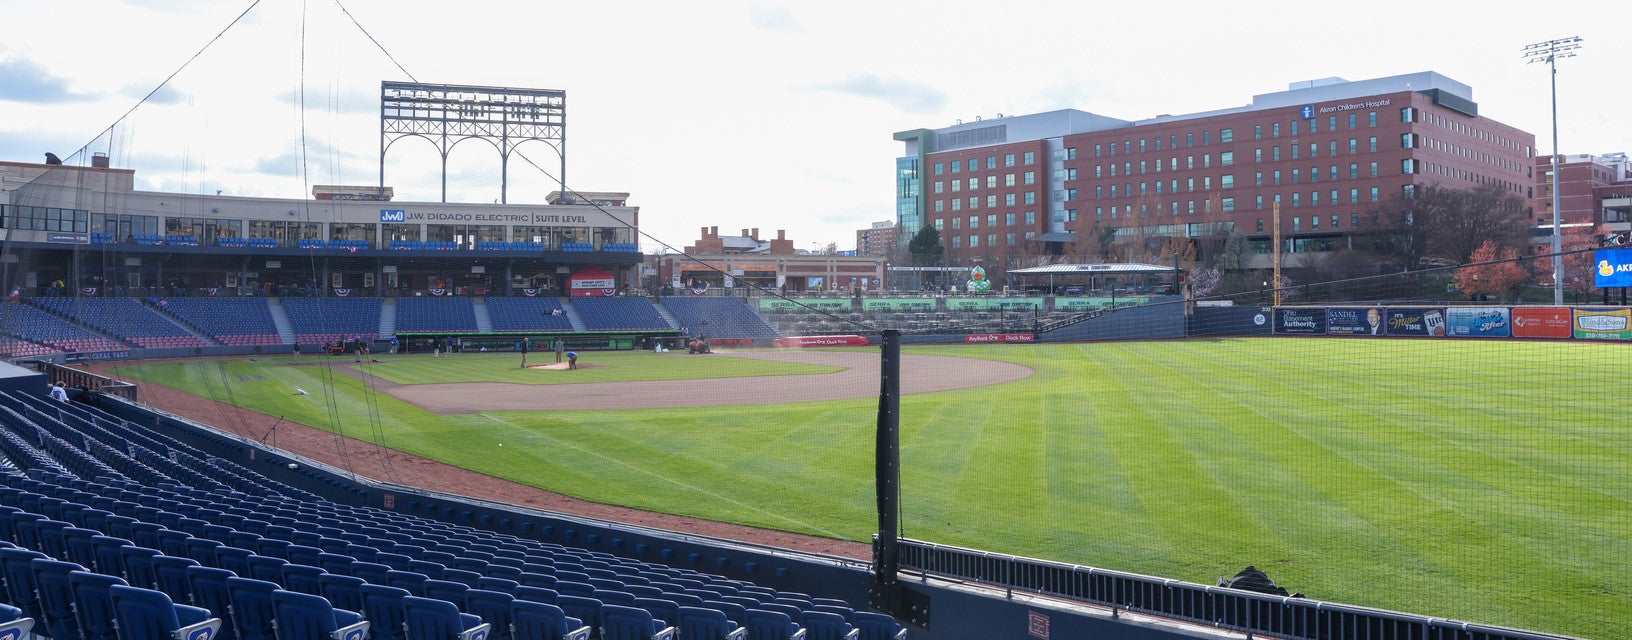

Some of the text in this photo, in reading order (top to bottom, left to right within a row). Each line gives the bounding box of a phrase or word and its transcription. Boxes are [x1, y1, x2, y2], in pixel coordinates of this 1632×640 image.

[1320, 99, 1391, 114] Akron Children's Hospital
[427, 213, 472, 221] DIDADO
[475, 214, 529, 222] ELECTRIC
[535, 215, 587, 223] SUITE LEVEL
[1283, 320, 1317, 328] Authority
[1388, 316, 1421, 330] Miller
[1479, 321, 1505, 332] After
